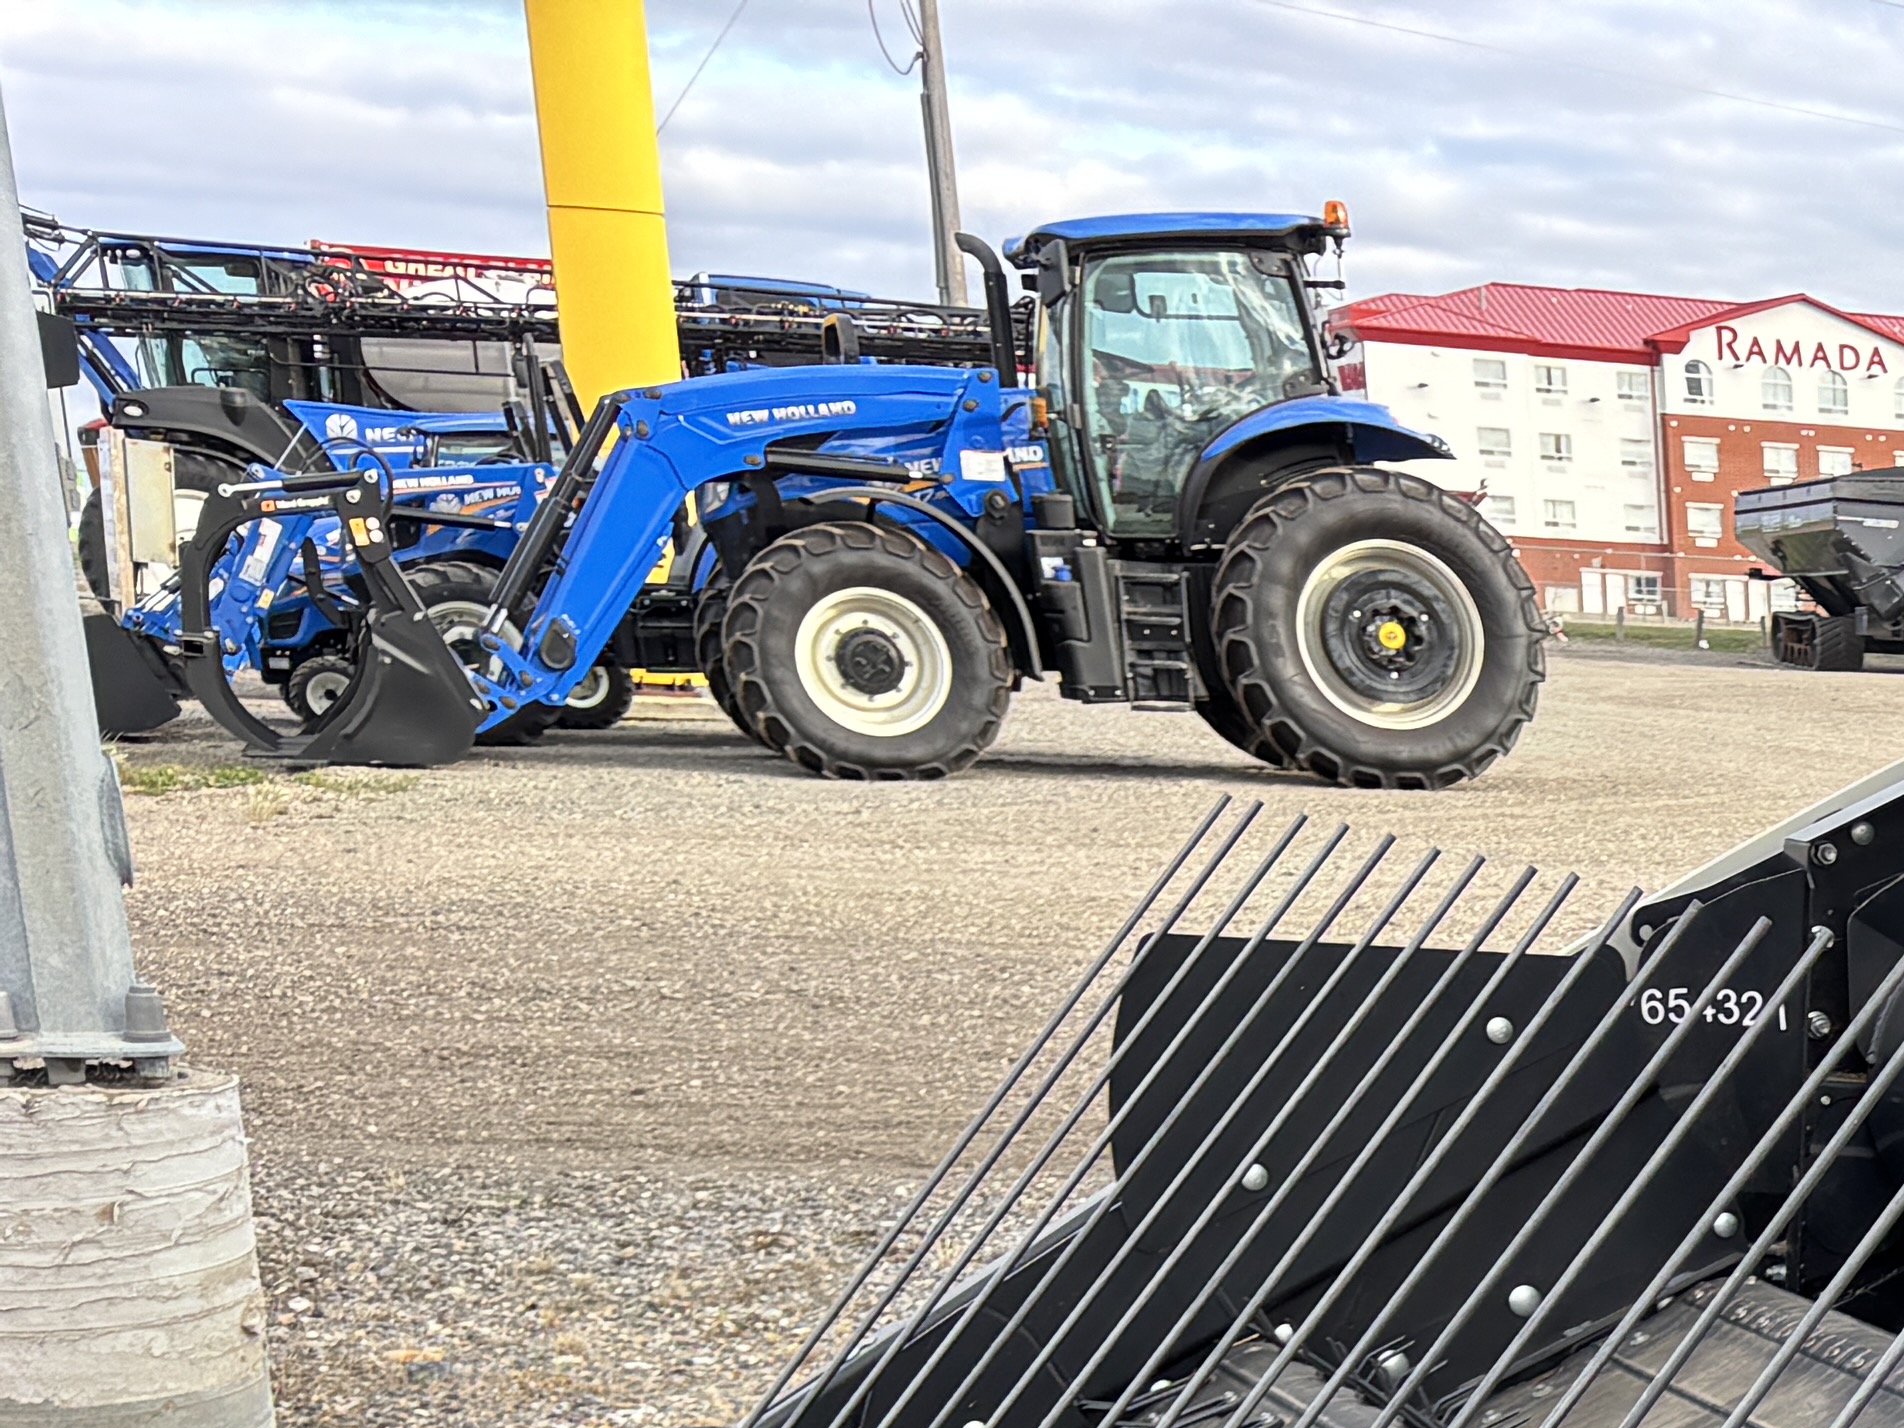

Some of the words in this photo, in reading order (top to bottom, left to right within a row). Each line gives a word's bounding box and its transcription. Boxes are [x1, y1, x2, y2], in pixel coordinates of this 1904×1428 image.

[1715, 325, 1888, 374] RAMADA
[726, 408, 770, 425] NEW
[773, 400, 857, 421] HOLLAND
